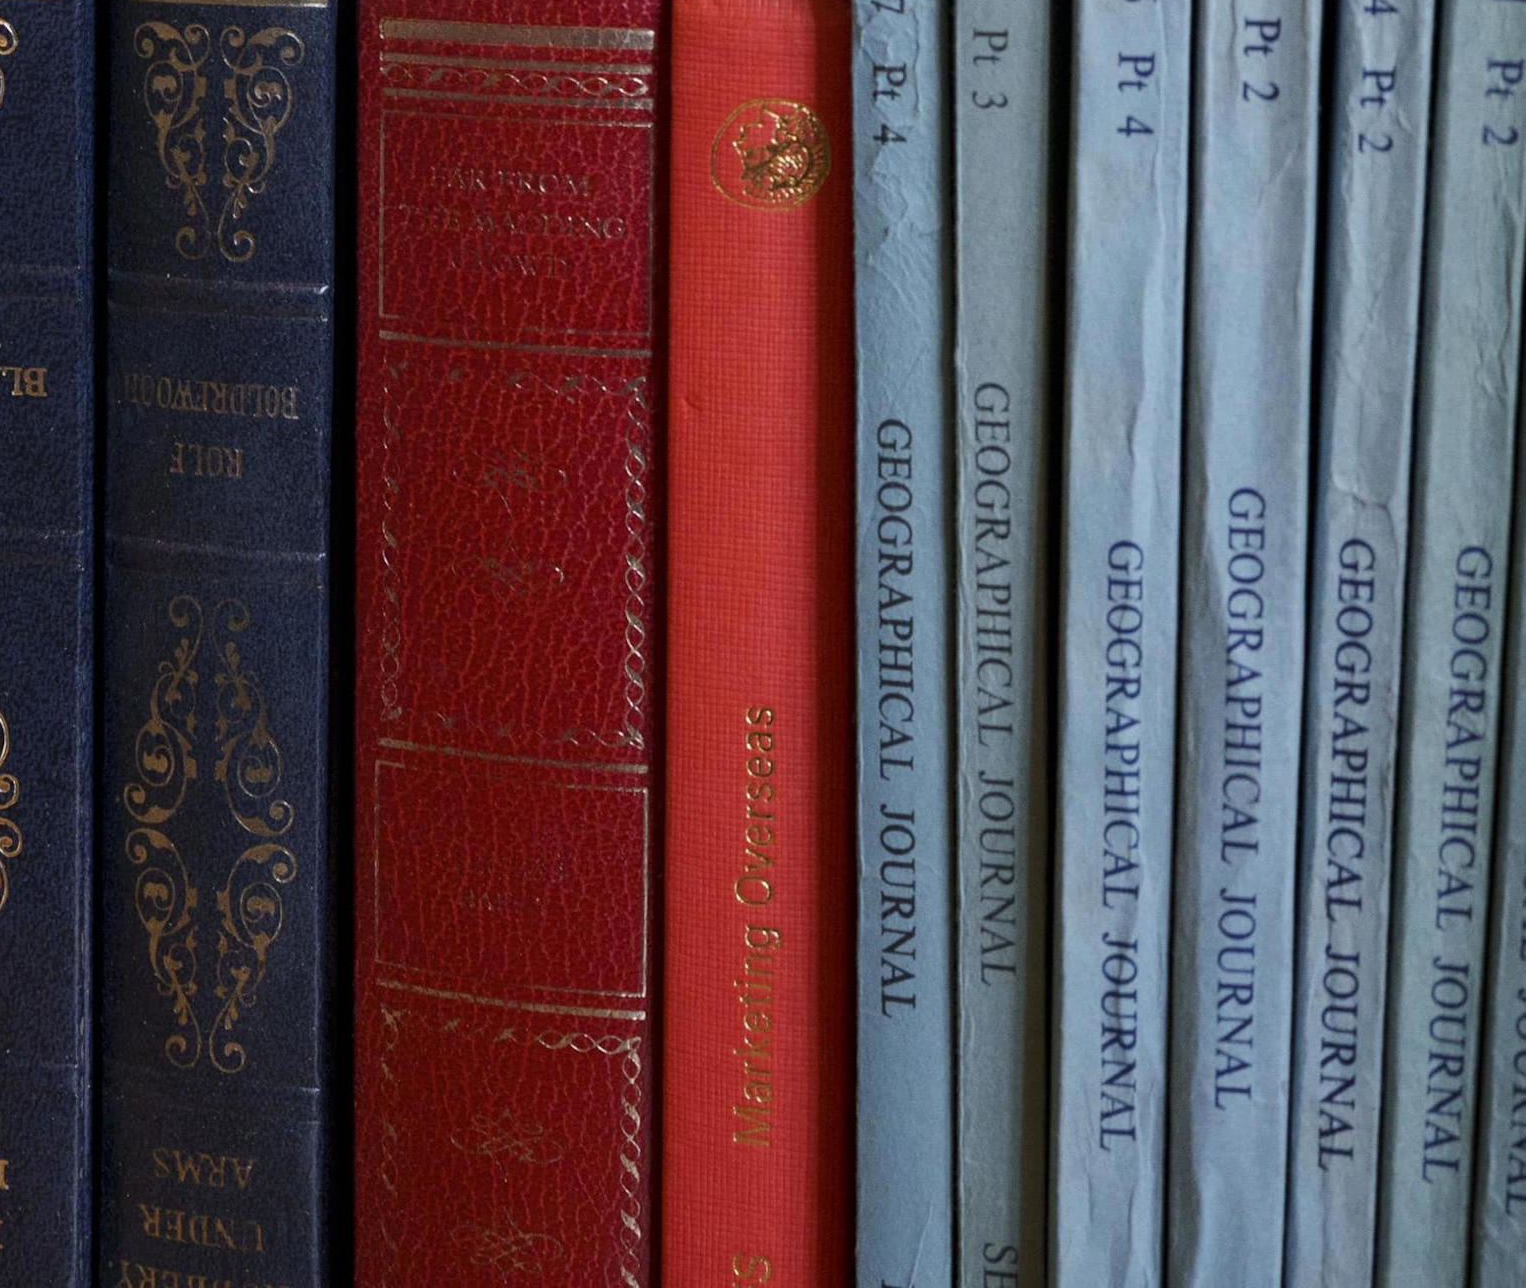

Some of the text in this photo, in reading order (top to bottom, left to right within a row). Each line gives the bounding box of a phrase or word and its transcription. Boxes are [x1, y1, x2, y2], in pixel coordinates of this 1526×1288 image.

[972, 28, 1009, 66] Pt
[1243, 16, 1282, 58] Pt
[871, 63, 906, 102] Pt
[1117, 51, 1156, 93] Pt
[1242, 80, 1281, 104] 2
[1358, 67, 1397, 109] Pt
[1482, 58, 1524, 99] Pt
[972, 90, 1009, 110] 3
[872, 123, 908, 146] 4
[1116, 115, 1155, 138] 4
[1357, 131, 1394, 154] 2
[1481, 123, 1520, 147] 2
[168, 441, 244, 480] ROLF
[973, 382, 1019, 987] GEOGRAPHICAL JOURNAL
[875, 418, 918, 1019] GEOGRAPHICAL JOURNAL
[1213, 487, 1267, 1111] GEOGRAPHICAL JOURNAL
[1098, 540, 1145, 1153] GEOGRAPHICAL JOURNAL
[1317, 537, 1377, 1173] GEOGRAPHICAL JOURNAL
[1421, 545, 1494, 1186] GEOGRAPHICAL JOURNAL
[732, 704, 783, 1147] Marketing Overseas
[149, 1146, 258, 1190] ARMS
[137, 1203, 267, 1254] UNDER
